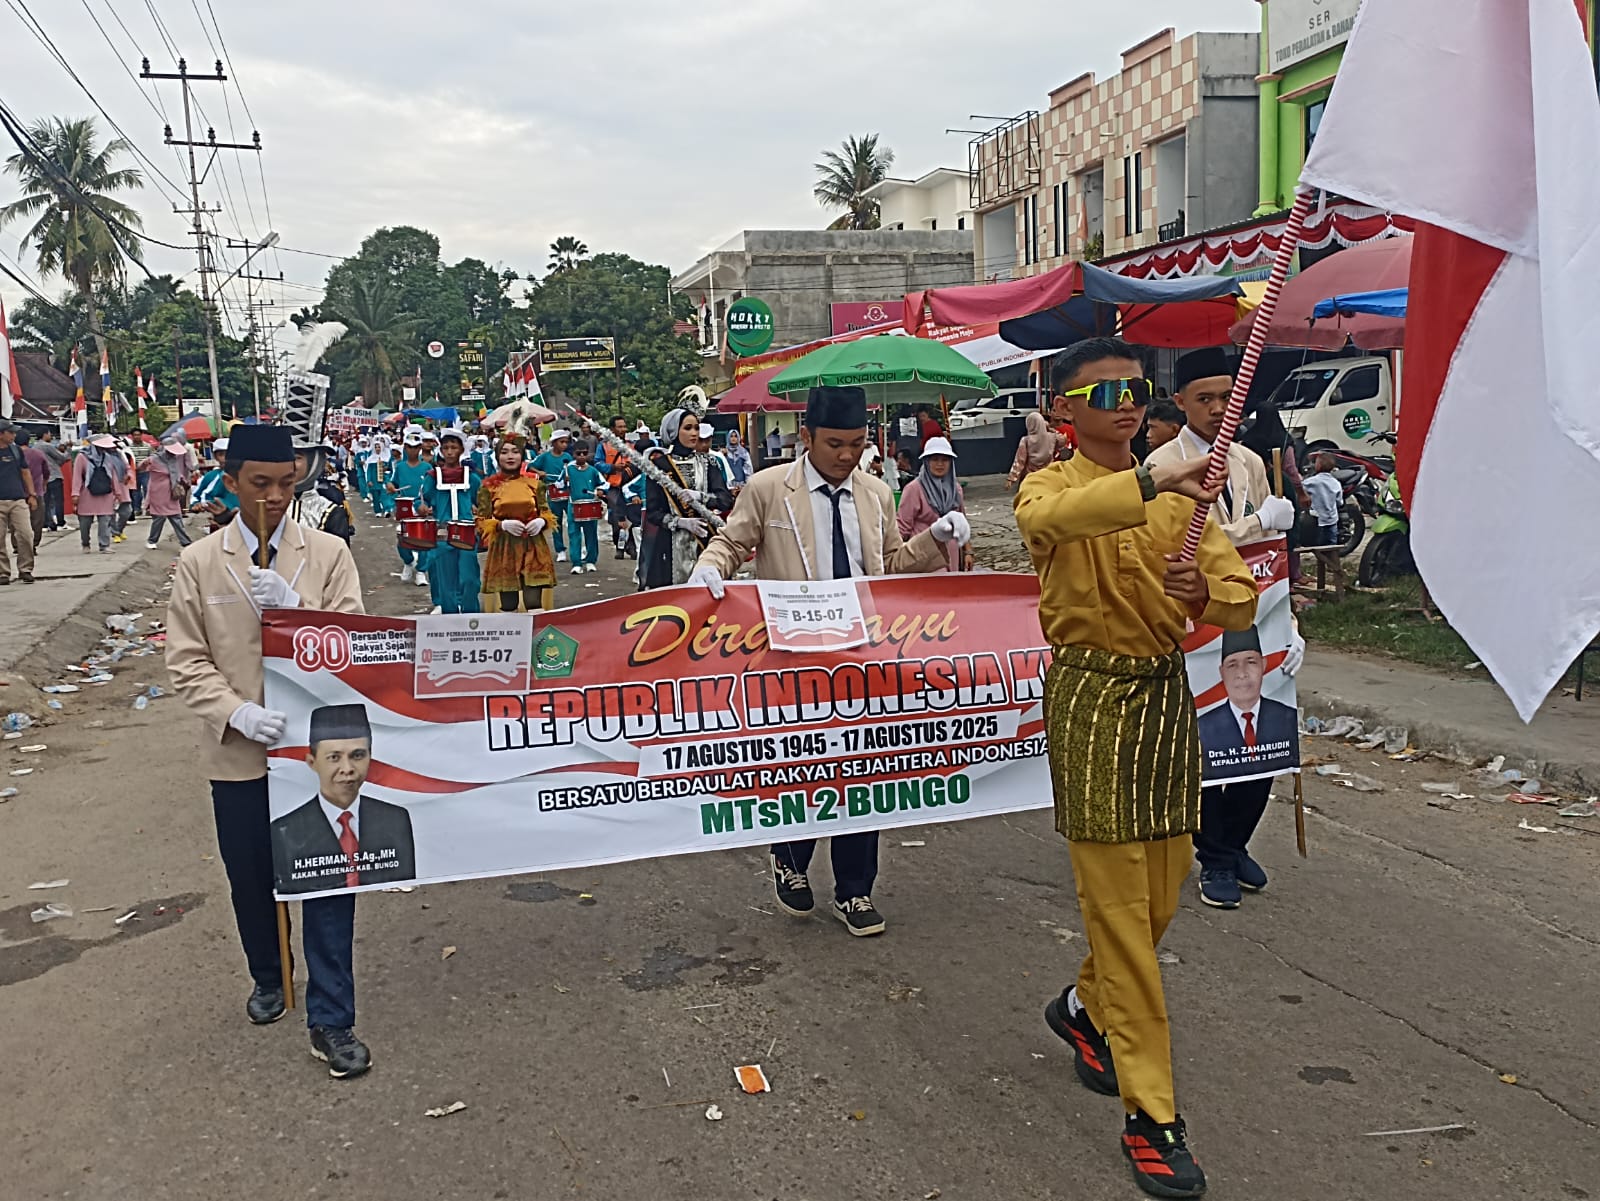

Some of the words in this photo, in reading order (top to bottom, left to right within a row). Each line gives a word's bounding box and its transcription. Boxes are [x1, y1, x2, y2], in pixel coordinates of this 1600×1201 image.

[1275, 45, 1291, 63] TOKO
[1292, 30, 1325, 56] PERALATAN
[731, 312, 769, 324] HOKKY
[934, 333, 960, 341] donesia
[459, 353, 483, 362] SAFARI
[976, 359, 1002, 368] EPUBLIK
[836, 372, 897, 385] KONAKOPI
[929, 373, 976, 386] KONAKOPI
[1253, 562, 1273, 577] AK
[791, 608, 844, 622] B-15-07
[351, 632, 387, 641] Bersatu
[293, 625, 351, 673] 80
[352, 643, 384, 653] Rakyat
[353, 653, 397, 663] Indonesia
[452, 649, 513, 664] B-15-07
[487, 675, 741, 750] REPUBLIK
[743, 654, 1008, 728] INDONESIA
[662, 747, 682, 769] 17
[687, 739, 777, 768] AGUSTUS
[780, 733, 827, 758] 1945
[841, 729, 860, 751] 17
[864, 721, 948, 748] AGUSTUS
[951, 715, 998, 738] 2025
[1208, 750, 1227, 758] Drs.
[1229, 748, 1239, 756] H.
[1241, 740, 1290, 755] ZAHARUDIN
[1211, 758, 1240, 767] KEPALA
[1268, 751, 1290, 759] BUNGO
[540, 782, 633, 810] BERSATU
[638, 772, 756, 800] BERDAULAT
[761, 763, 838, 786] RAKYAT
[841, 751, 948, 778] SEJAHTERA
[952, 739, 1049, 765] INDONESIA
[700, 793, 805, 835] MTsN
[816, 789, 838, 821] 2
[847, 774, 970, 818] BUNGO
[320, 865, 355, 876] KEMENAG
[375, 861, 399, 870] BUNGO
